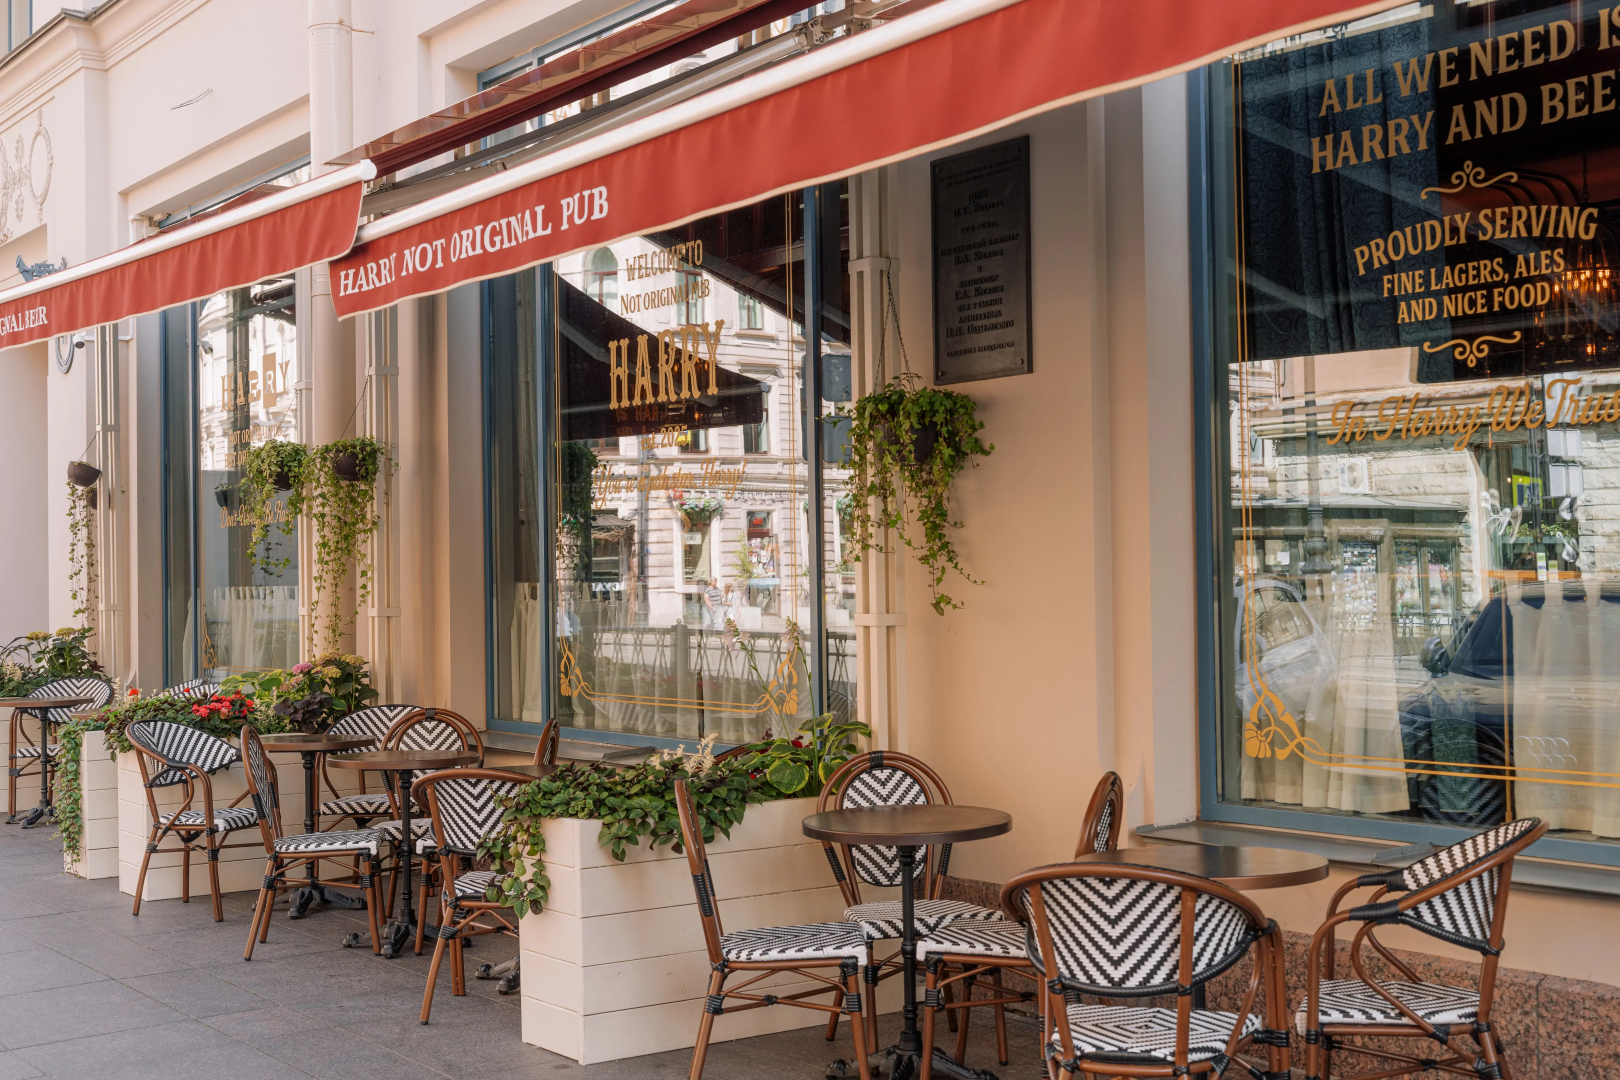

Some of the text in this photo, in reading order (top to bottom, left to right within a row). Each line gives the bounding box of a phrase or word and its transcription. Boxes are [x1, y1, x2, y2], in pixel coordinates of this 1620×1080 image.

[1318, 67, 1382, 117] ALL
[1393, 47, 1460, 97] WE
[1469, 20, 1576, 81] NEED
[1311, 69, 1620, 174] HARRY AND BEE
[339, 185, 609, 297] HARRY NOT ORIGINAL PUB
[625, 239, 703, 282] WELCOME TO
[1354, 205, 1599, 276] PROUDLY SERVING
[620, 279, 710, 315] NOT ORIGINAL PUB
[1382, 248, 1565, 298] FINE LAGERS, ALES
[1397, 282, 1550, 324] AND NICE FOOD
[608, 319, 725, 410] HARRY
[641, 424, 688, 450] est. 2025
[1326, 399, 1368, 445] In
[1373, 392, 1483, 451] Harry
[1487, 383, 1546, 432] We
[593, 464, 636, 510] You're
[700, 457, 748, 500] Harry!
